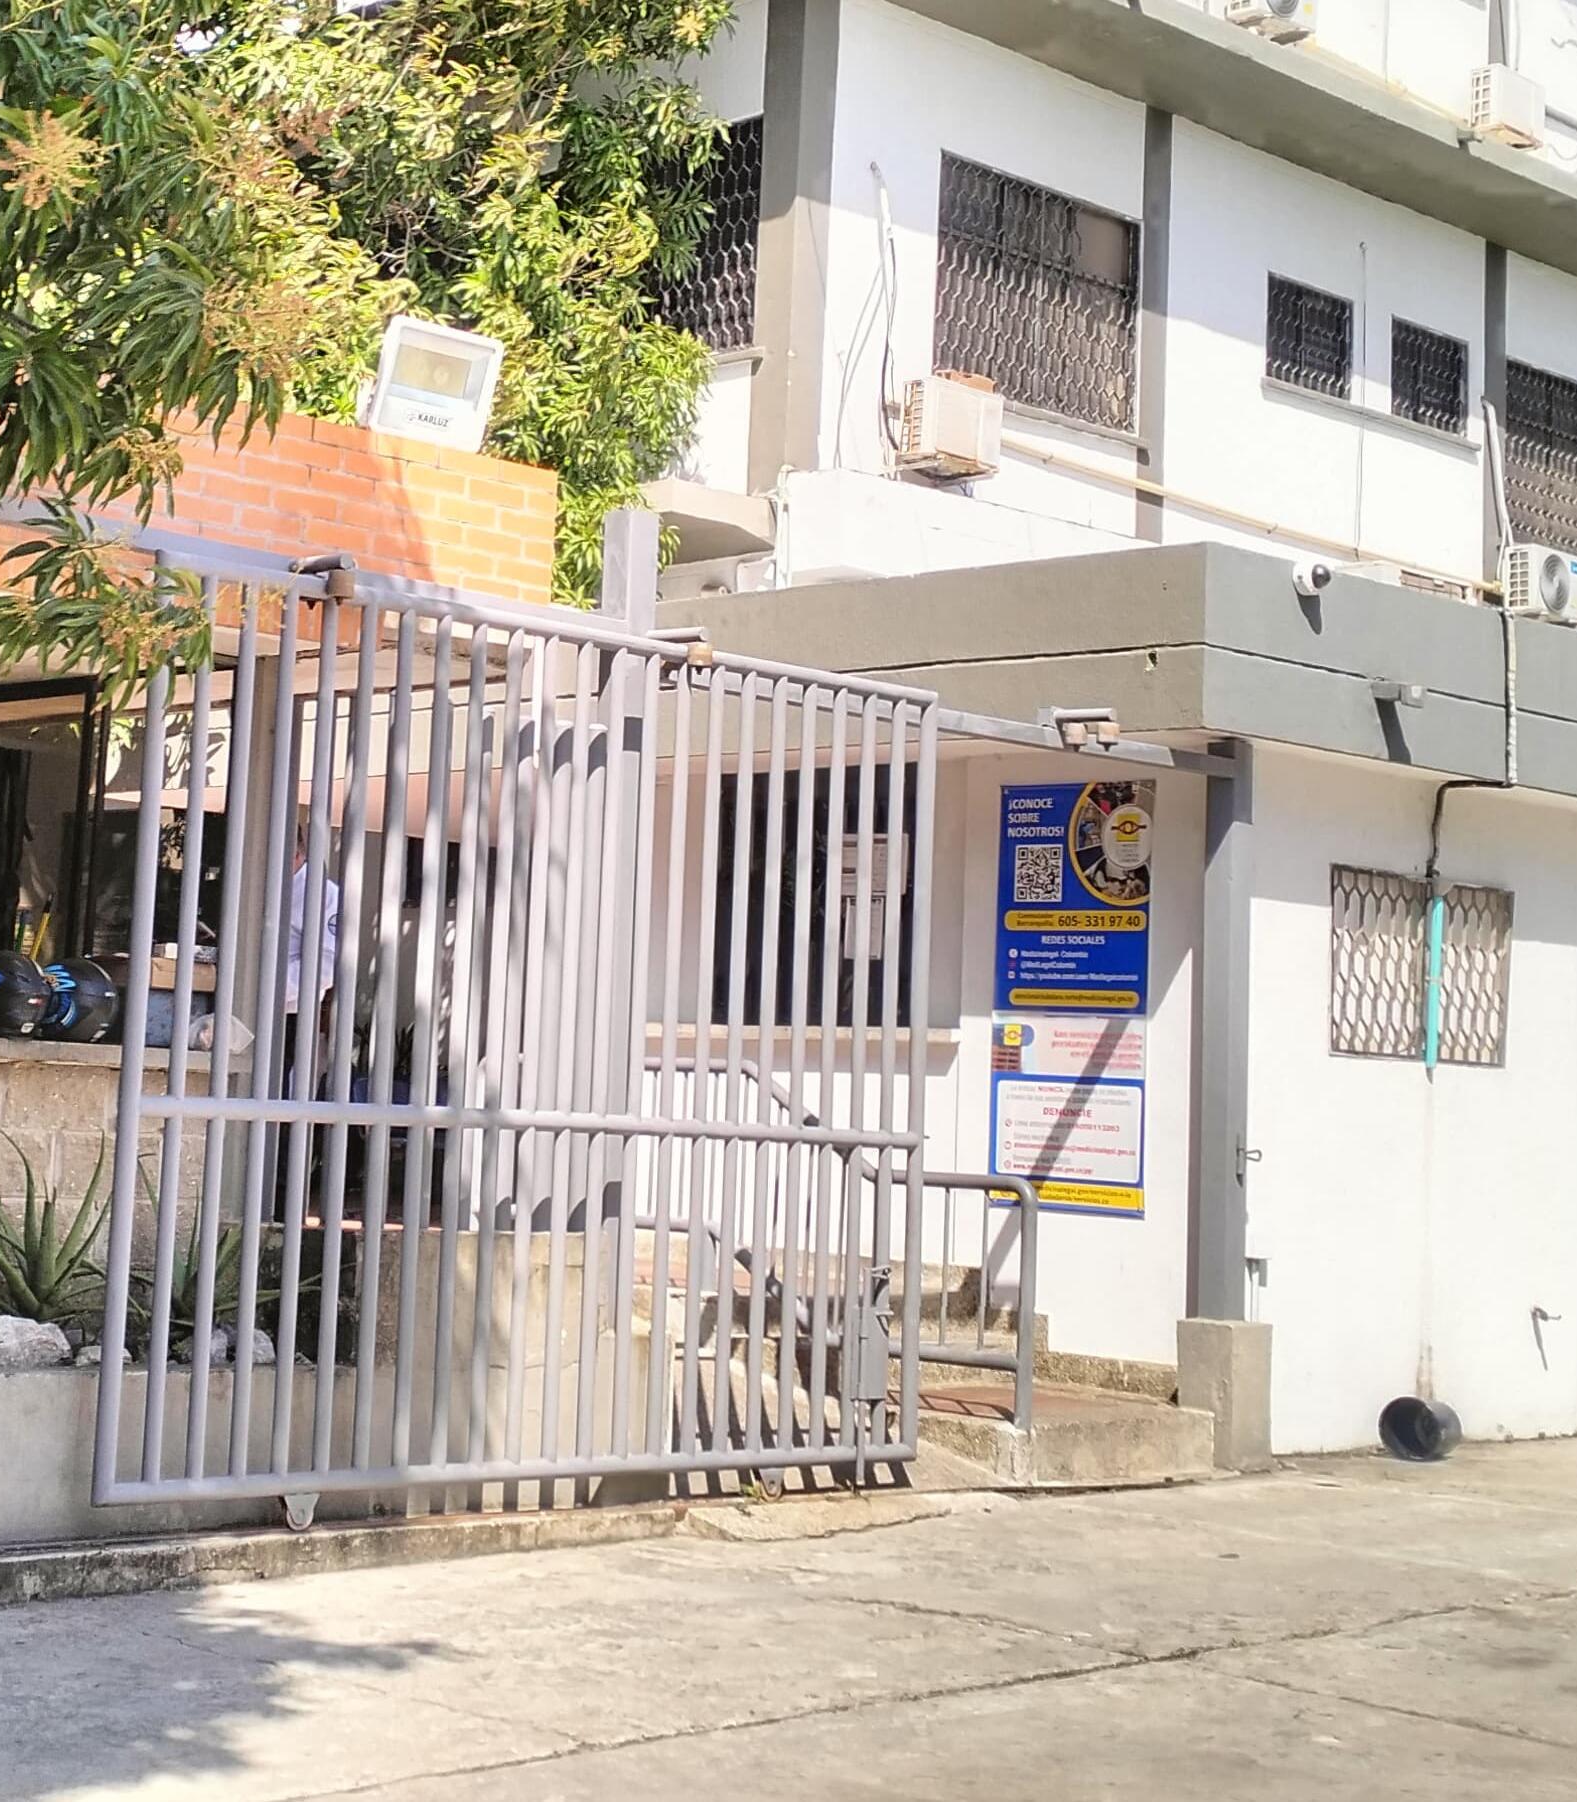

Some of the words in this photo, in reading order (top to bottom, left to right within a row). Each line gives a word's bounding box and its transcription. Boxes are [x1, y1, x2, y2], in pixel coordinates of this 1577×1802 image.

[1008, 798, 1054, 811] ¡CONOCE
[1008, 813, 1041, 823] SOBRE
[1008, 826, 1064, 838] NOSOTROS!
[1058, 915, 1081, 927] 605-
[1084, 915, 1105, 927] 331
[1109, 915, 1123, 927] 97
[1126, 915, 1141, 927] 40
[1041, 935, 1065, 945] REDES
[1067, 935, 1105, 945] SOCIALES
[1043, 1106, 1093, 1118] DENUNCIE
